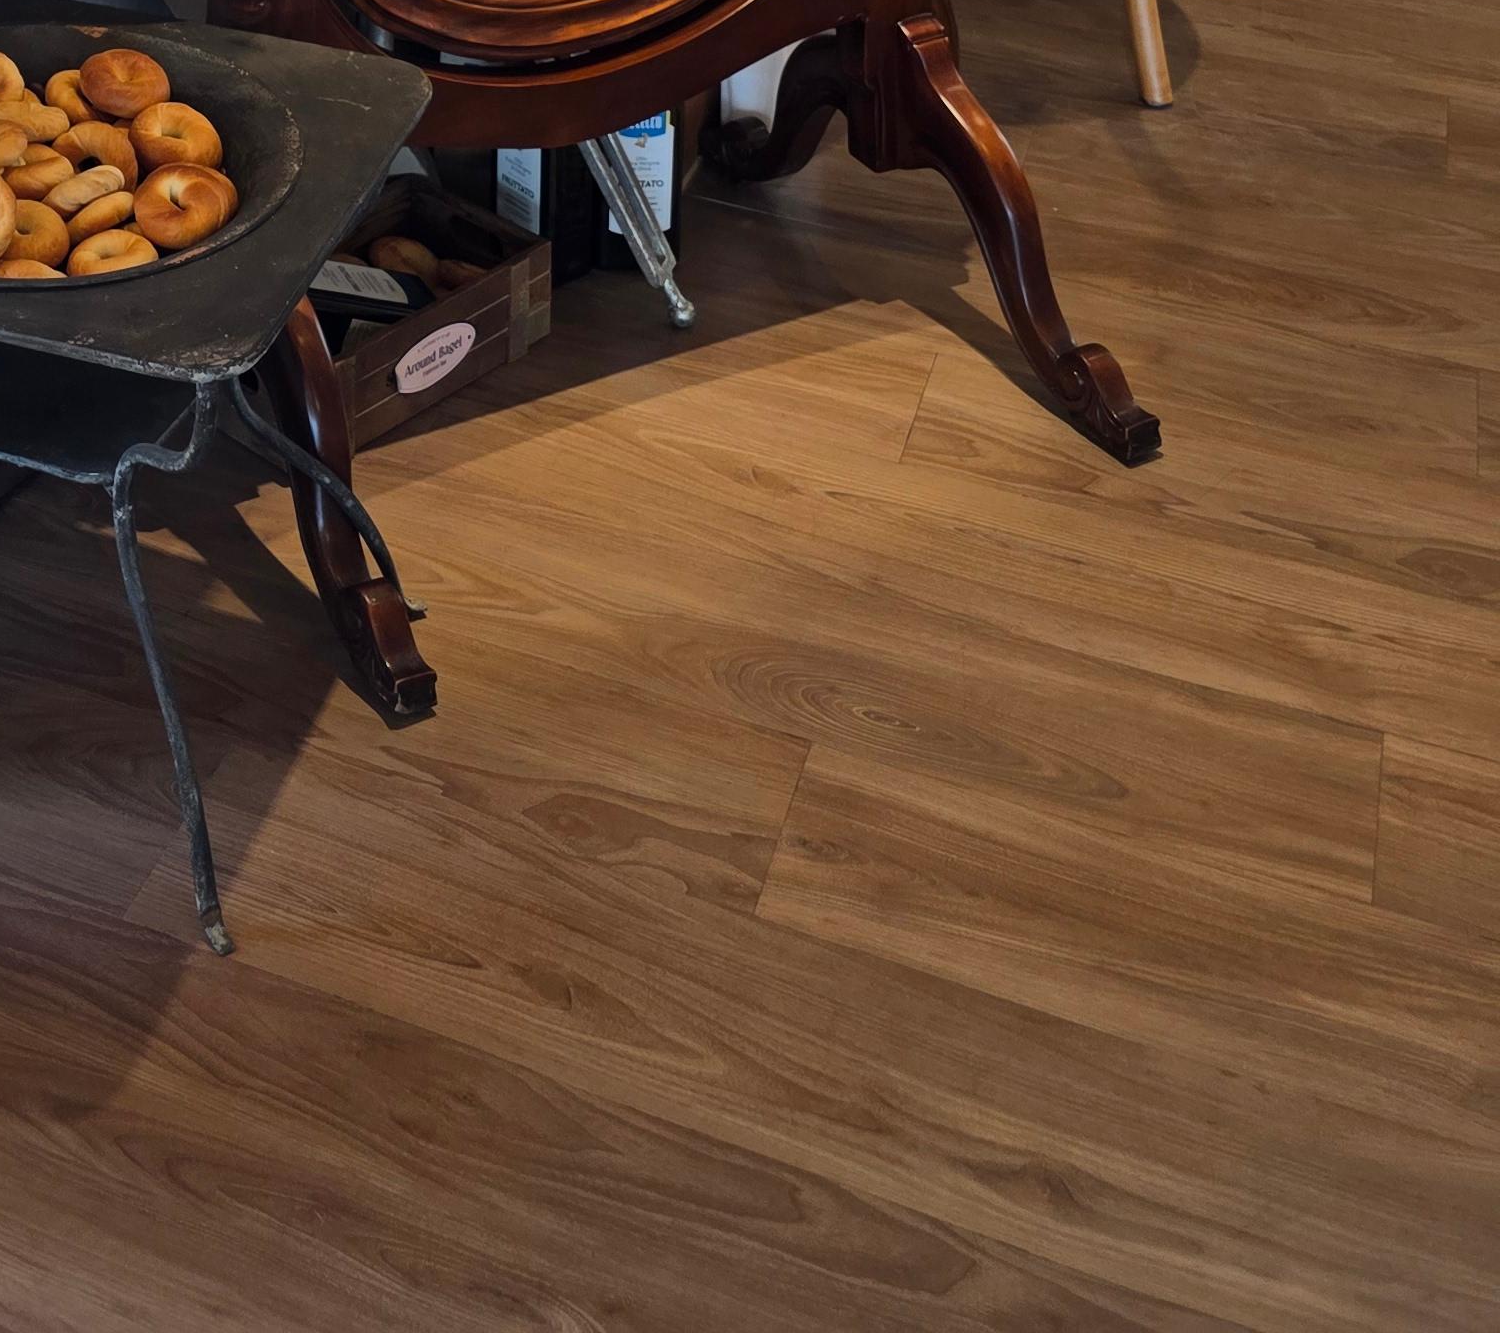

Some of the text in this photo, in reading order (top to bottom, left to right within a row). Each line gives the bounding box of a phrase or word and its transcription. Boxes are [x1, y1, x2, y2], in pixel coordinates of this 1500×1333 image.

[501, 171, 535, 199] FRUTTATO
[404, 350, 437, 378] Around
[438, 334, 463, 359] Bagel
